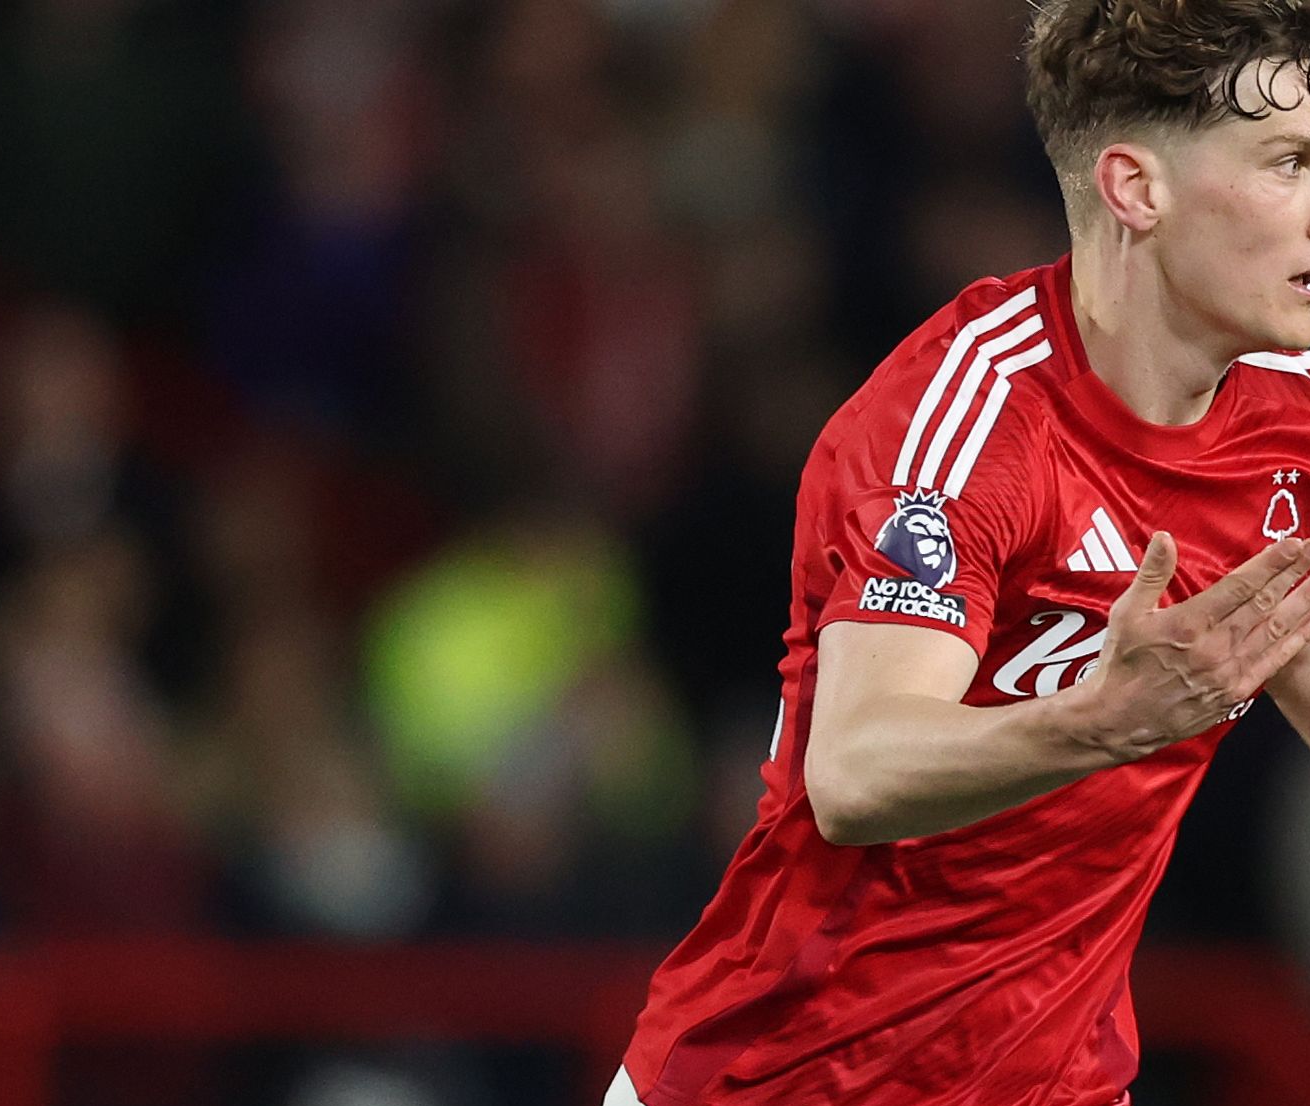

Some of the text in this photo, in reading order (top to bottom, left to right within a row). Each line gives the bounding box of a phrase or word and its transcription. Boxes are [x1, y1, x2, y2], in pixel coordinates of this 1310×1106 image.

[864, 577, 898, 596] No
[859, 591, 966, 628] for racism
